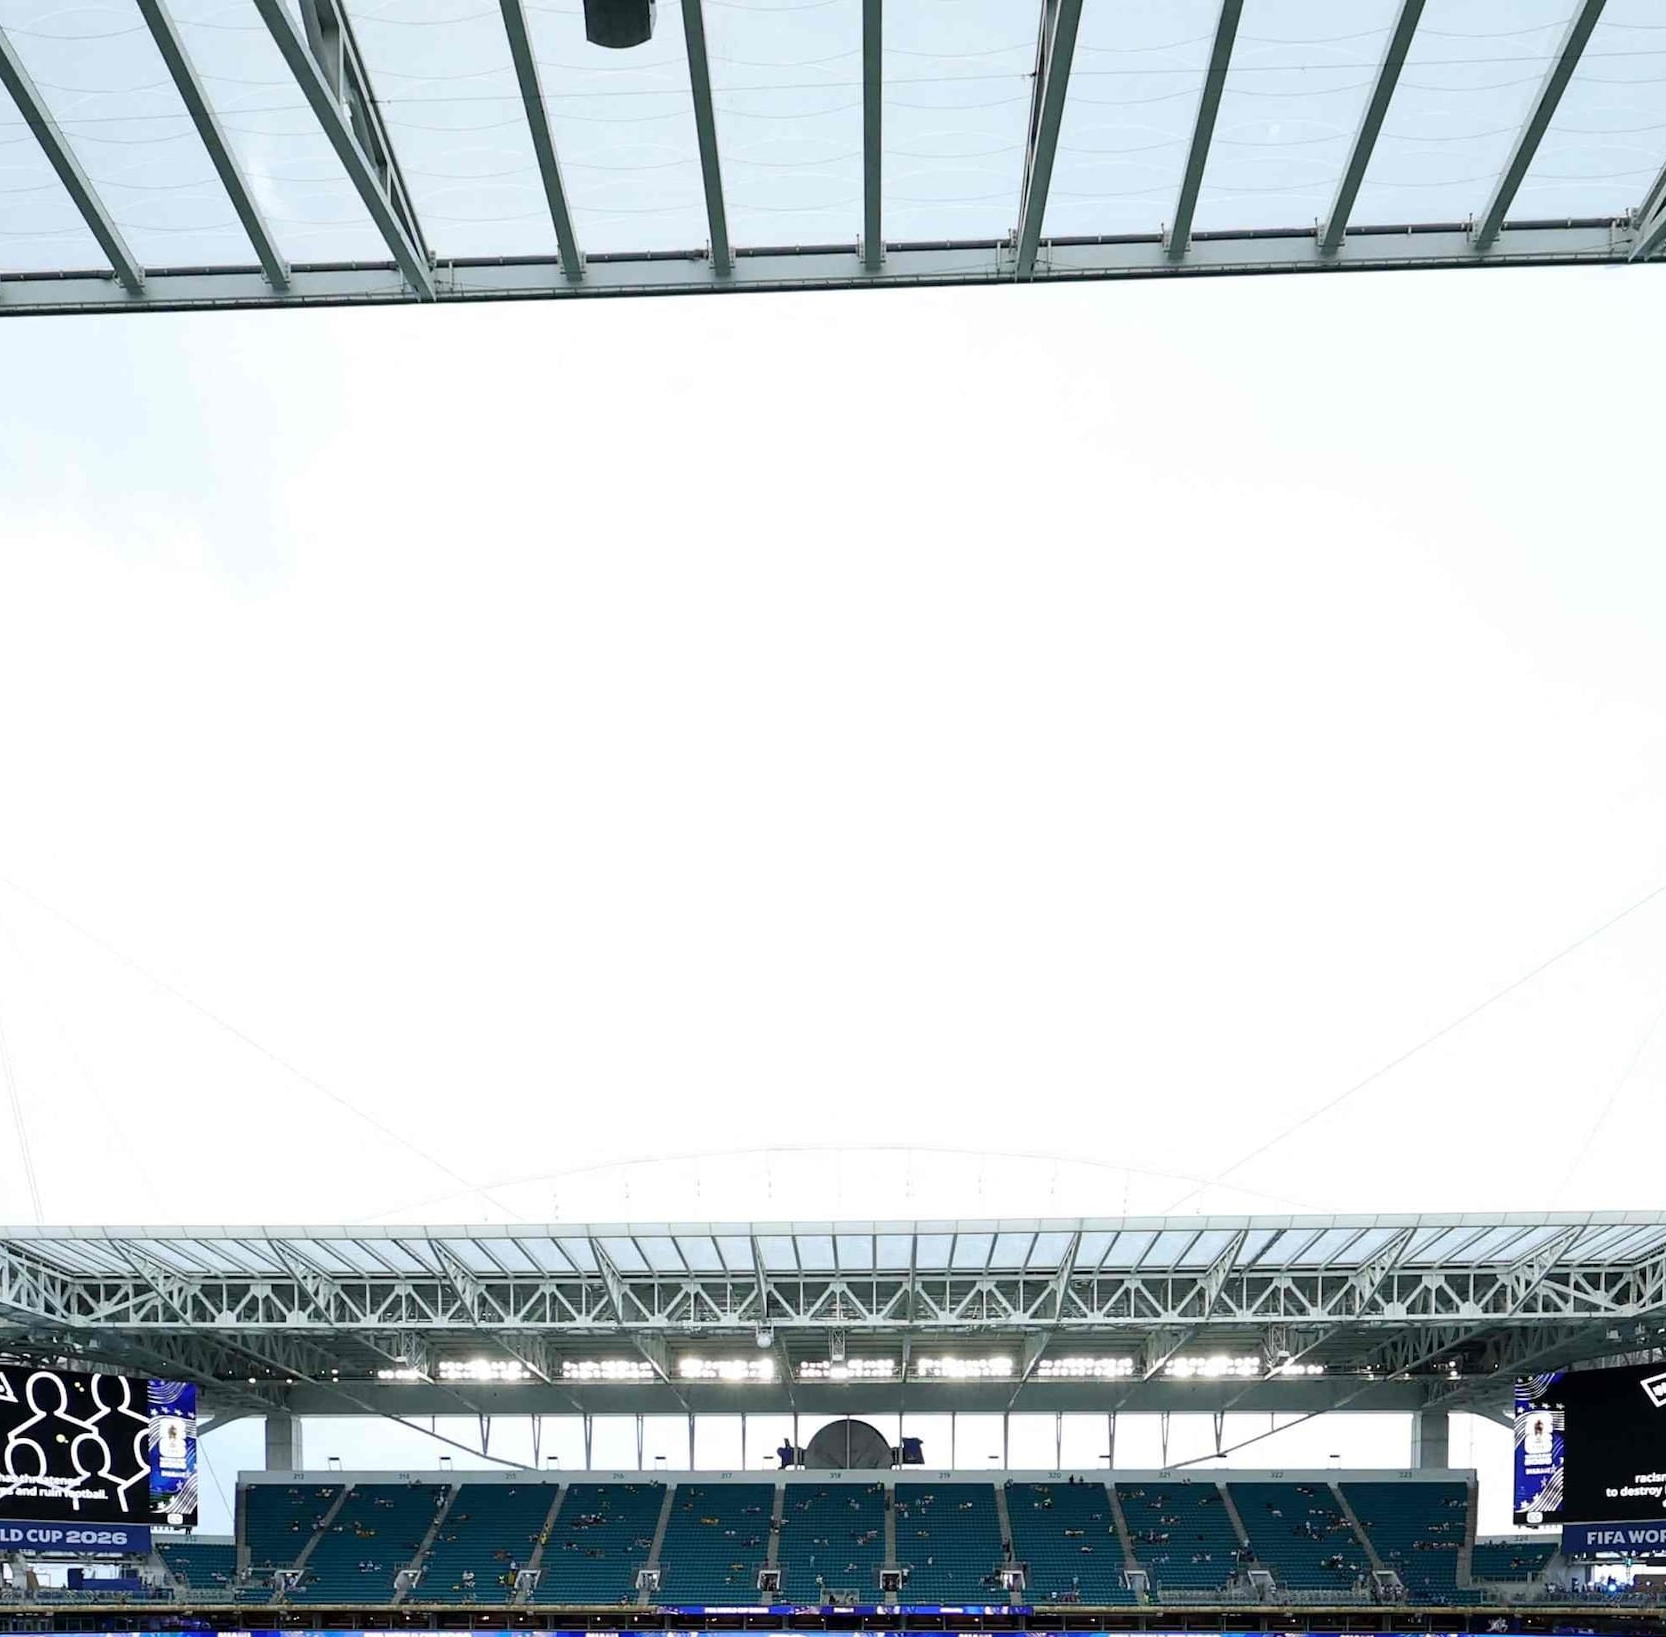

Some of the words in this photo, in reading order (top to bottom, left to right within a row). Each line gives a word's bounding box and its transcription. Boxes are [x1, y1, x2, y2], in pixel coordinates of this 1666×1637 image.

[15, 1485, 37, 1496] and
[39, 1487, 63, 1497] ruin
[1606, 1488, 1618, 1497] to
[1620, 1485, 1662, 1500] destroy
[25, 1530, 63, 1543] CUP
[65, 1531, 127, 1545] 2026
[1586, 1530, 1622, 1545] FIFA
